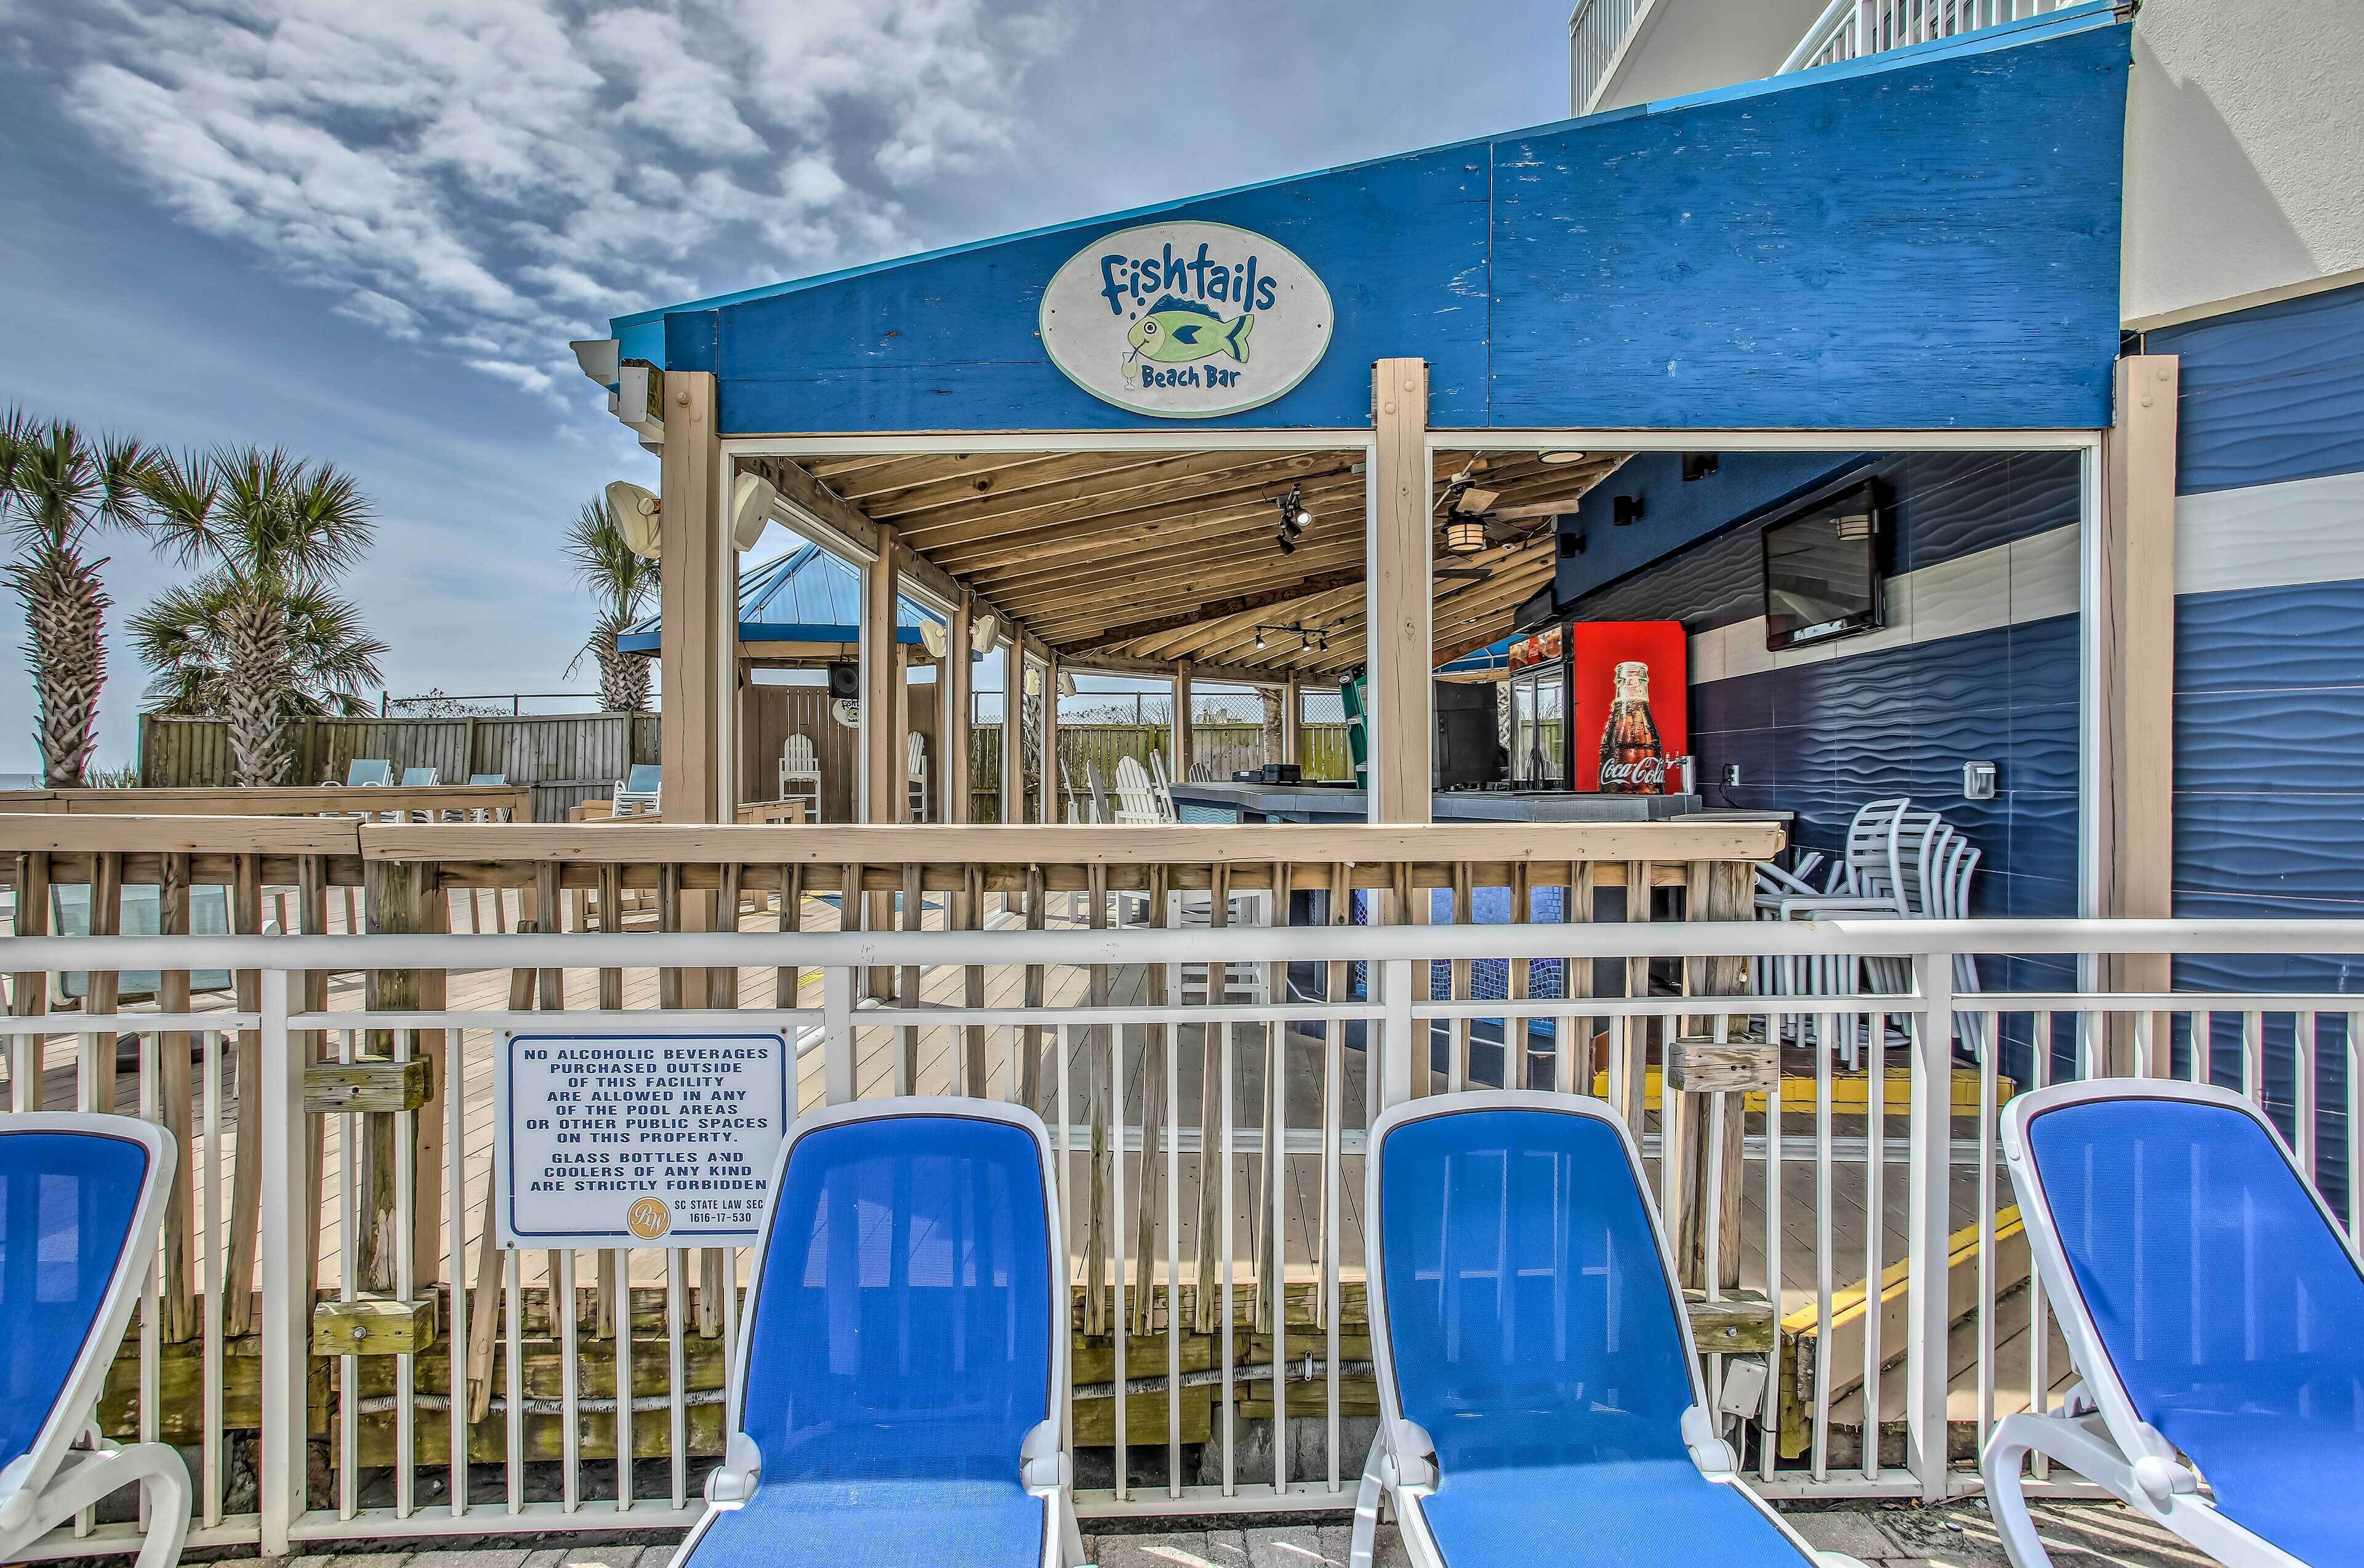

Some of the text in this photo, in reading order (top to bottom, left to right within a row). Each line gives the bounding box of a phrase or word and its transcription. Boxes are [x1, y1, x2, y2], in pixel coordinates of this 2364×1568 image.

[1101, 243, 1277, 315] Fishtails
[1141, 364, 1241, 388] Beach Bar
[1601, 757, 1665, 785] Coca-Cola
[525, 1048, 768, 1060] NO ALCOHOLIC BEVERAGES
[550, 1063, 742, 1074] PURCHASED OUTSIDE
[568, 1077, 725, 1088] OF THIS FACILITY
[547, 1090, 747, 1102] ARE ALLOWED IN ANY
[556, 1104, 738, 1116] OF THE POOL AREAS
[526, 1118, 768, 1130] OR OTHER PUBLIC SPACES
[557, 1132, 738, 1143] ON THIS PROPERTY.
[552, 1152, 744, 1164] GLASS BOTTLES AND
[544, 1166, 752, 1178] COOLERS OF ANY KIND
[530, 1180, 766, 1191] ARE STRICTLY FORBIDDEN
[674, 1199, 763, 1210] SC STATE LAW SEC
[690, 1212, 751, 1223] 1616-17-530
